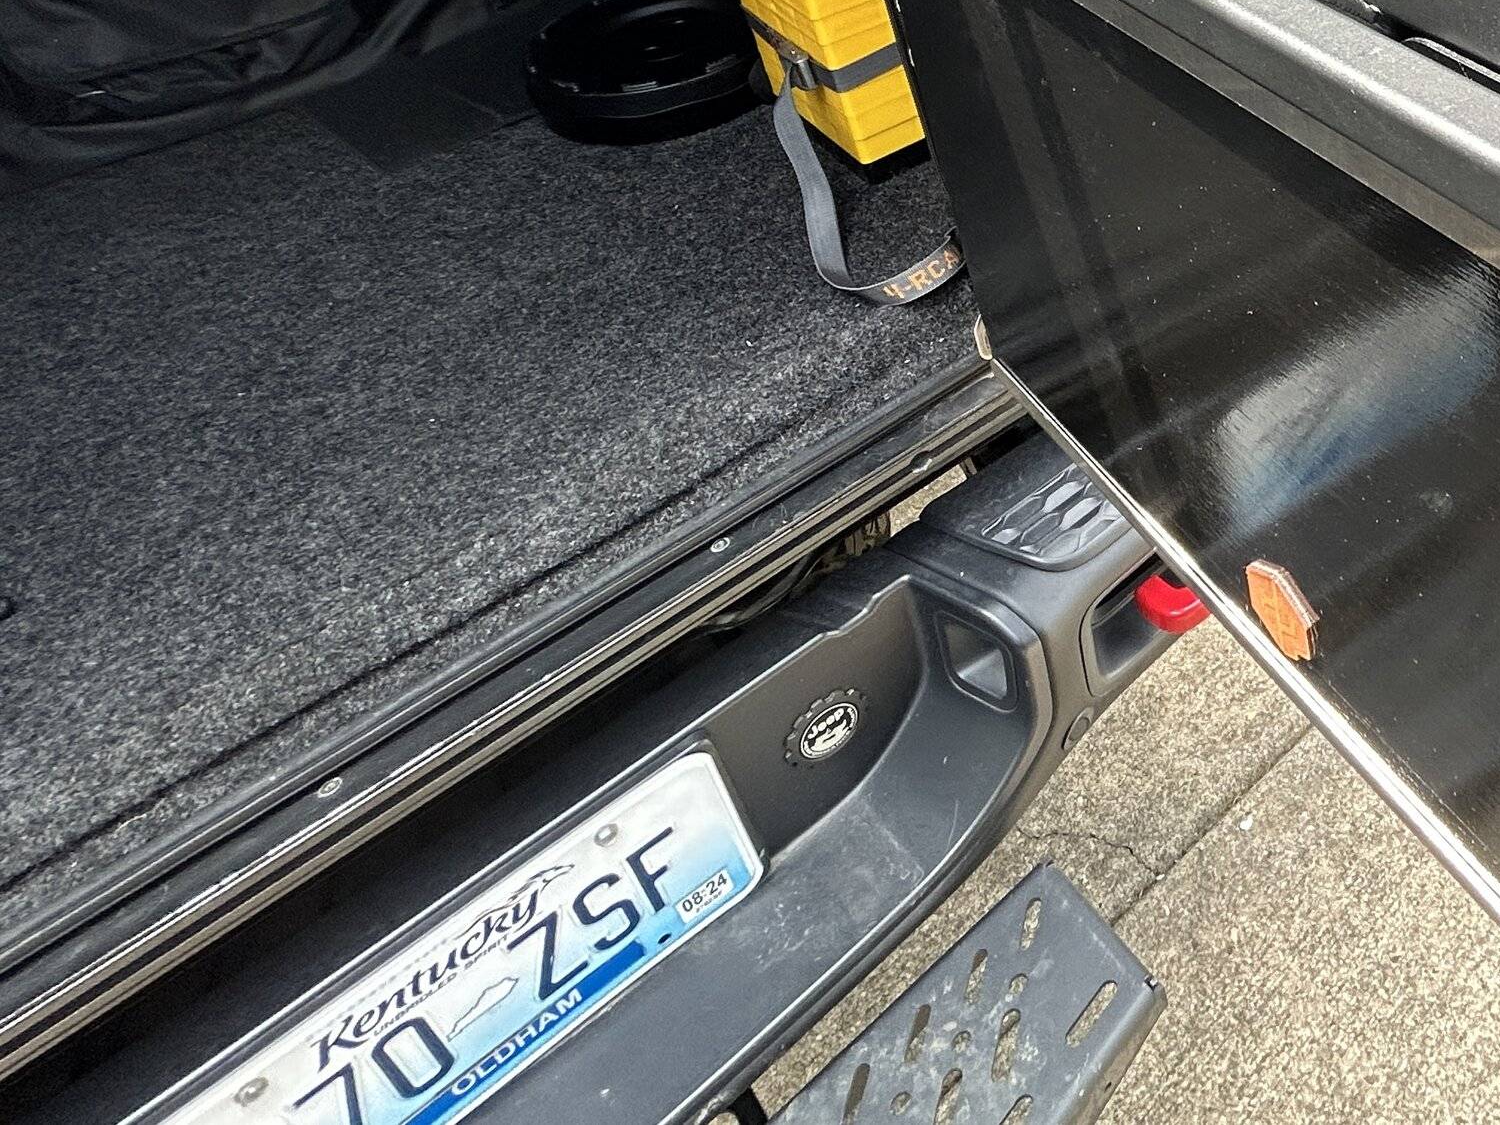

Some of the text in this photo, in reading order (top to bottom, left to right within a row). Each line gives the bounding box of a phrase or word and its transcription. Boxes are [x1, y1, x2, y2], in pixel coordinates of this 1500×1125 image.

[807, 707, 845, 740] Jeep
[464, 933, 508, 971] SPIRIT
[506, 826, 674, 1001] ZSF
[310, 889, 538, 1073] Kentucky
[451, 987, 584, 1097] OLDHAM
